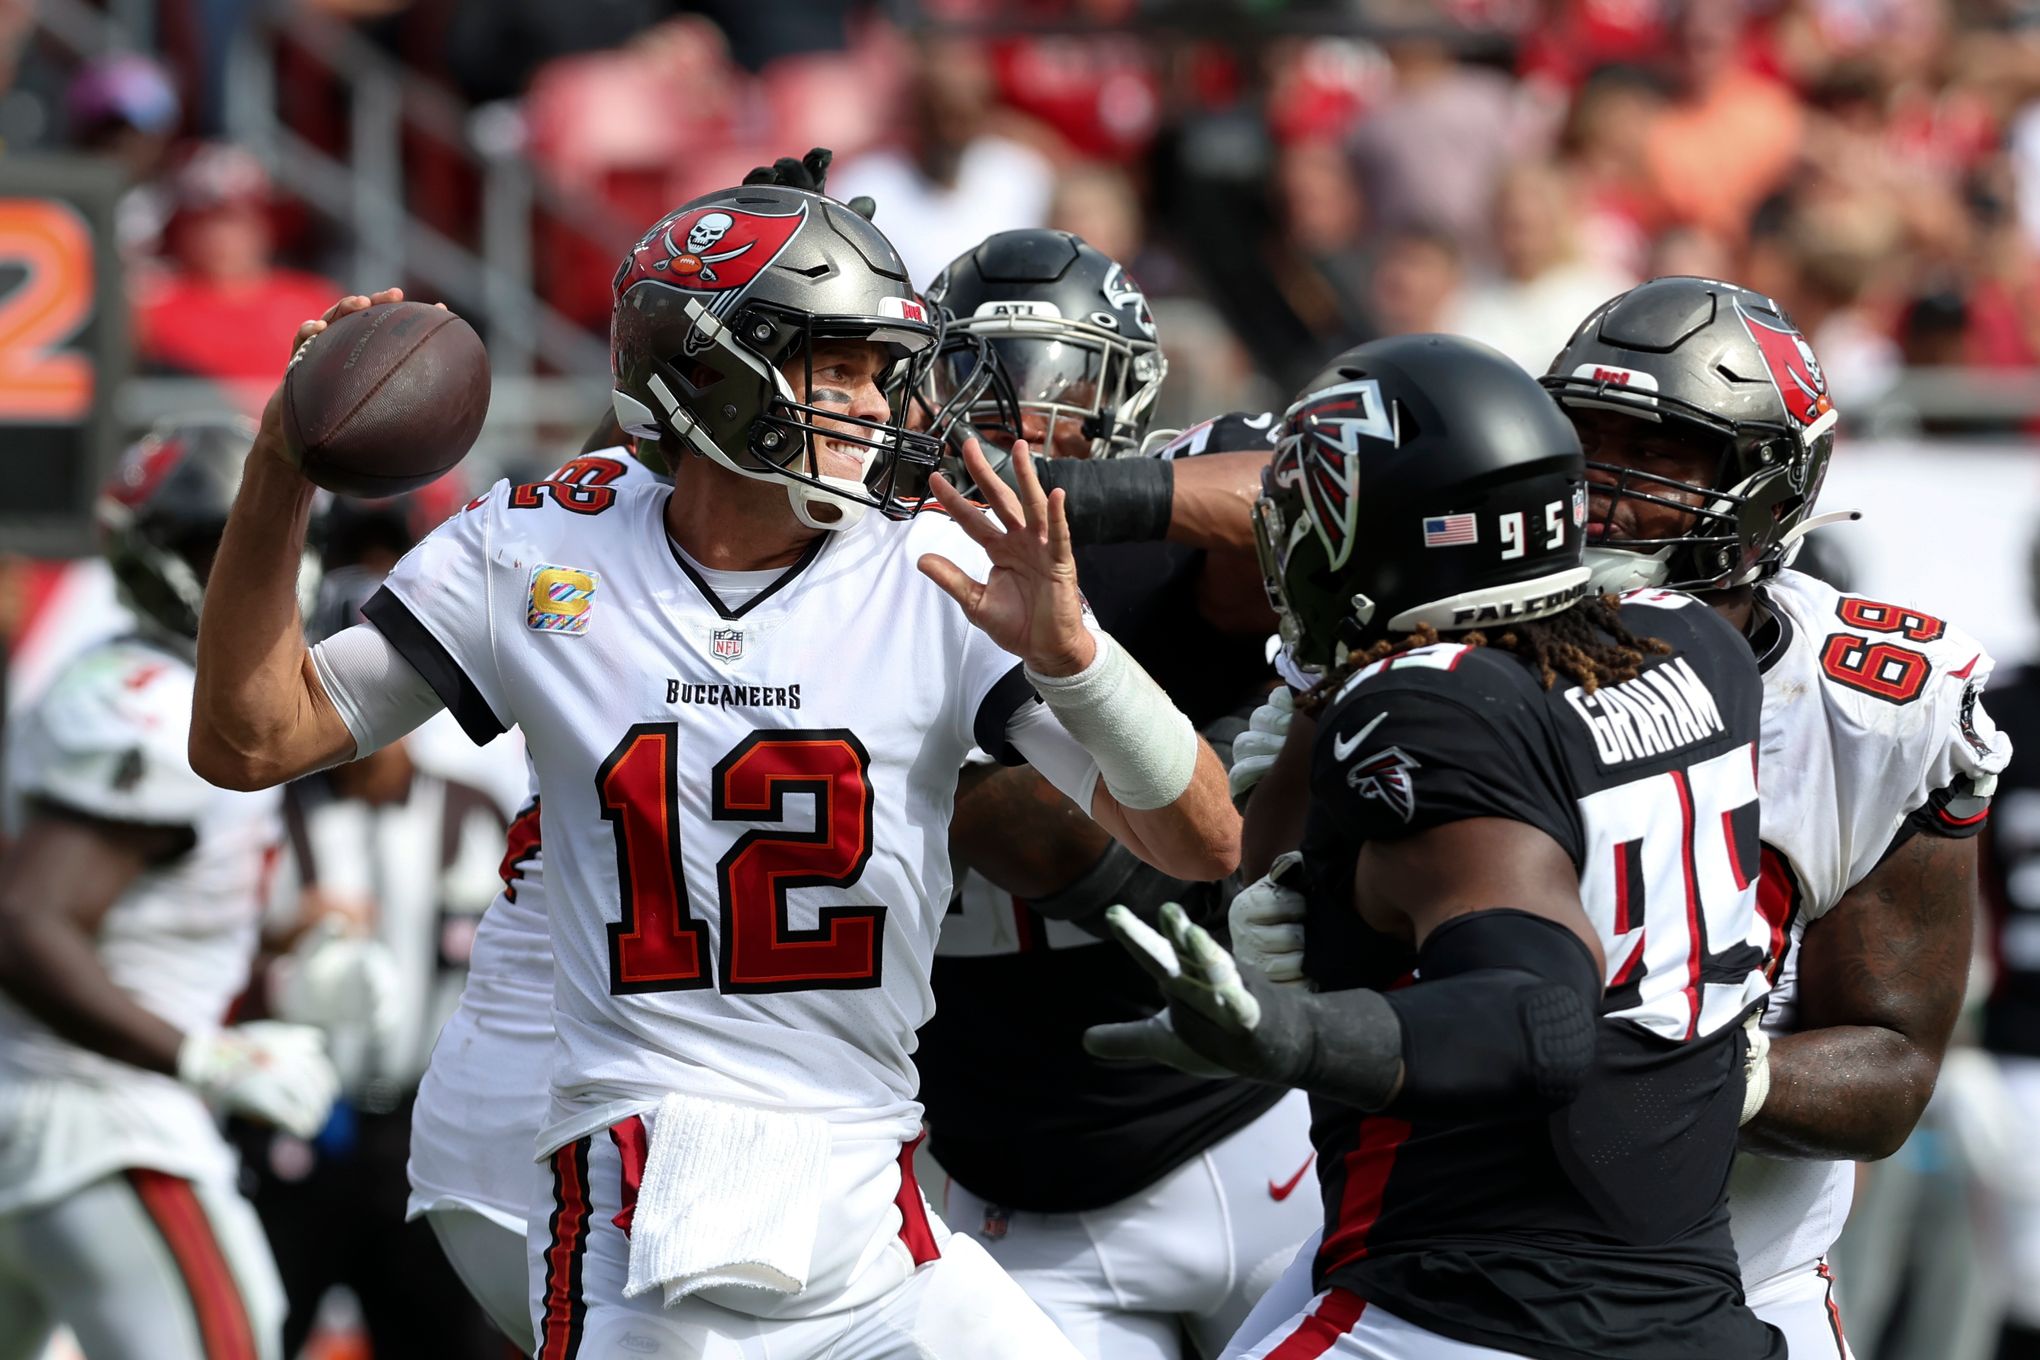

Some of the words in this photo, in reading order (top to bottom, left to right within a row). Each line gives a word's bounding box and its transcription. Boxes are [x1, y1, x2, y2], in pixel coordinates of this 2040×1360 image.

[0, 196, 97, 425] 2
[1500, 501, 1566, 560] 95
[533, 568, 594, 617] C
[666, 678, 801, 712] BUCCANEERS
[715, 640, 741, 655] NFL
[1819, 596, 1947, 706] 69
[1564, 656, 1725, 765] GRAHAM
[594, 722, 888, 995] 12
[1576, 741, 1773, 1042] 95
